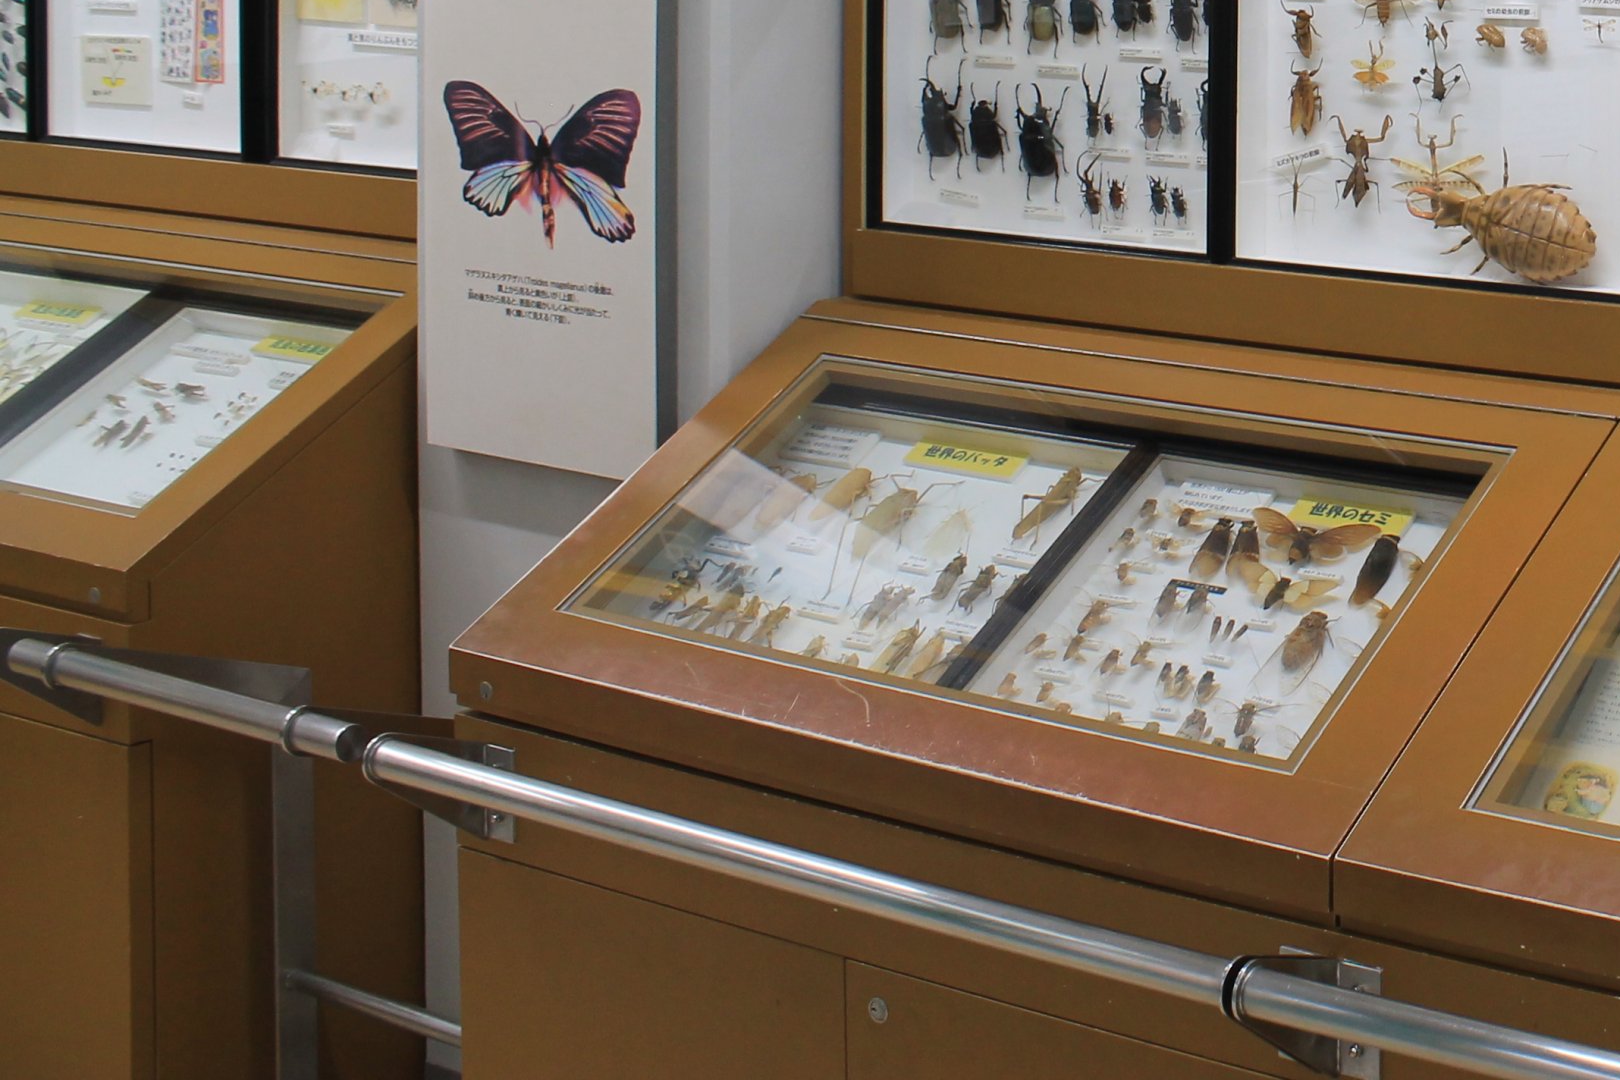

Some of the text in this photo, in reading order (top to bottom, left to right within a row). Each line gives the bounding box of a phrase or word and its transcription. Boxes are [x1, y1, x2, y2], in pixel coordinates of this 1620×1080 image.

[925, 445, 1008, 467] 世界のバッタ
[1310, 502, 1392, 525] 世界のセミ
